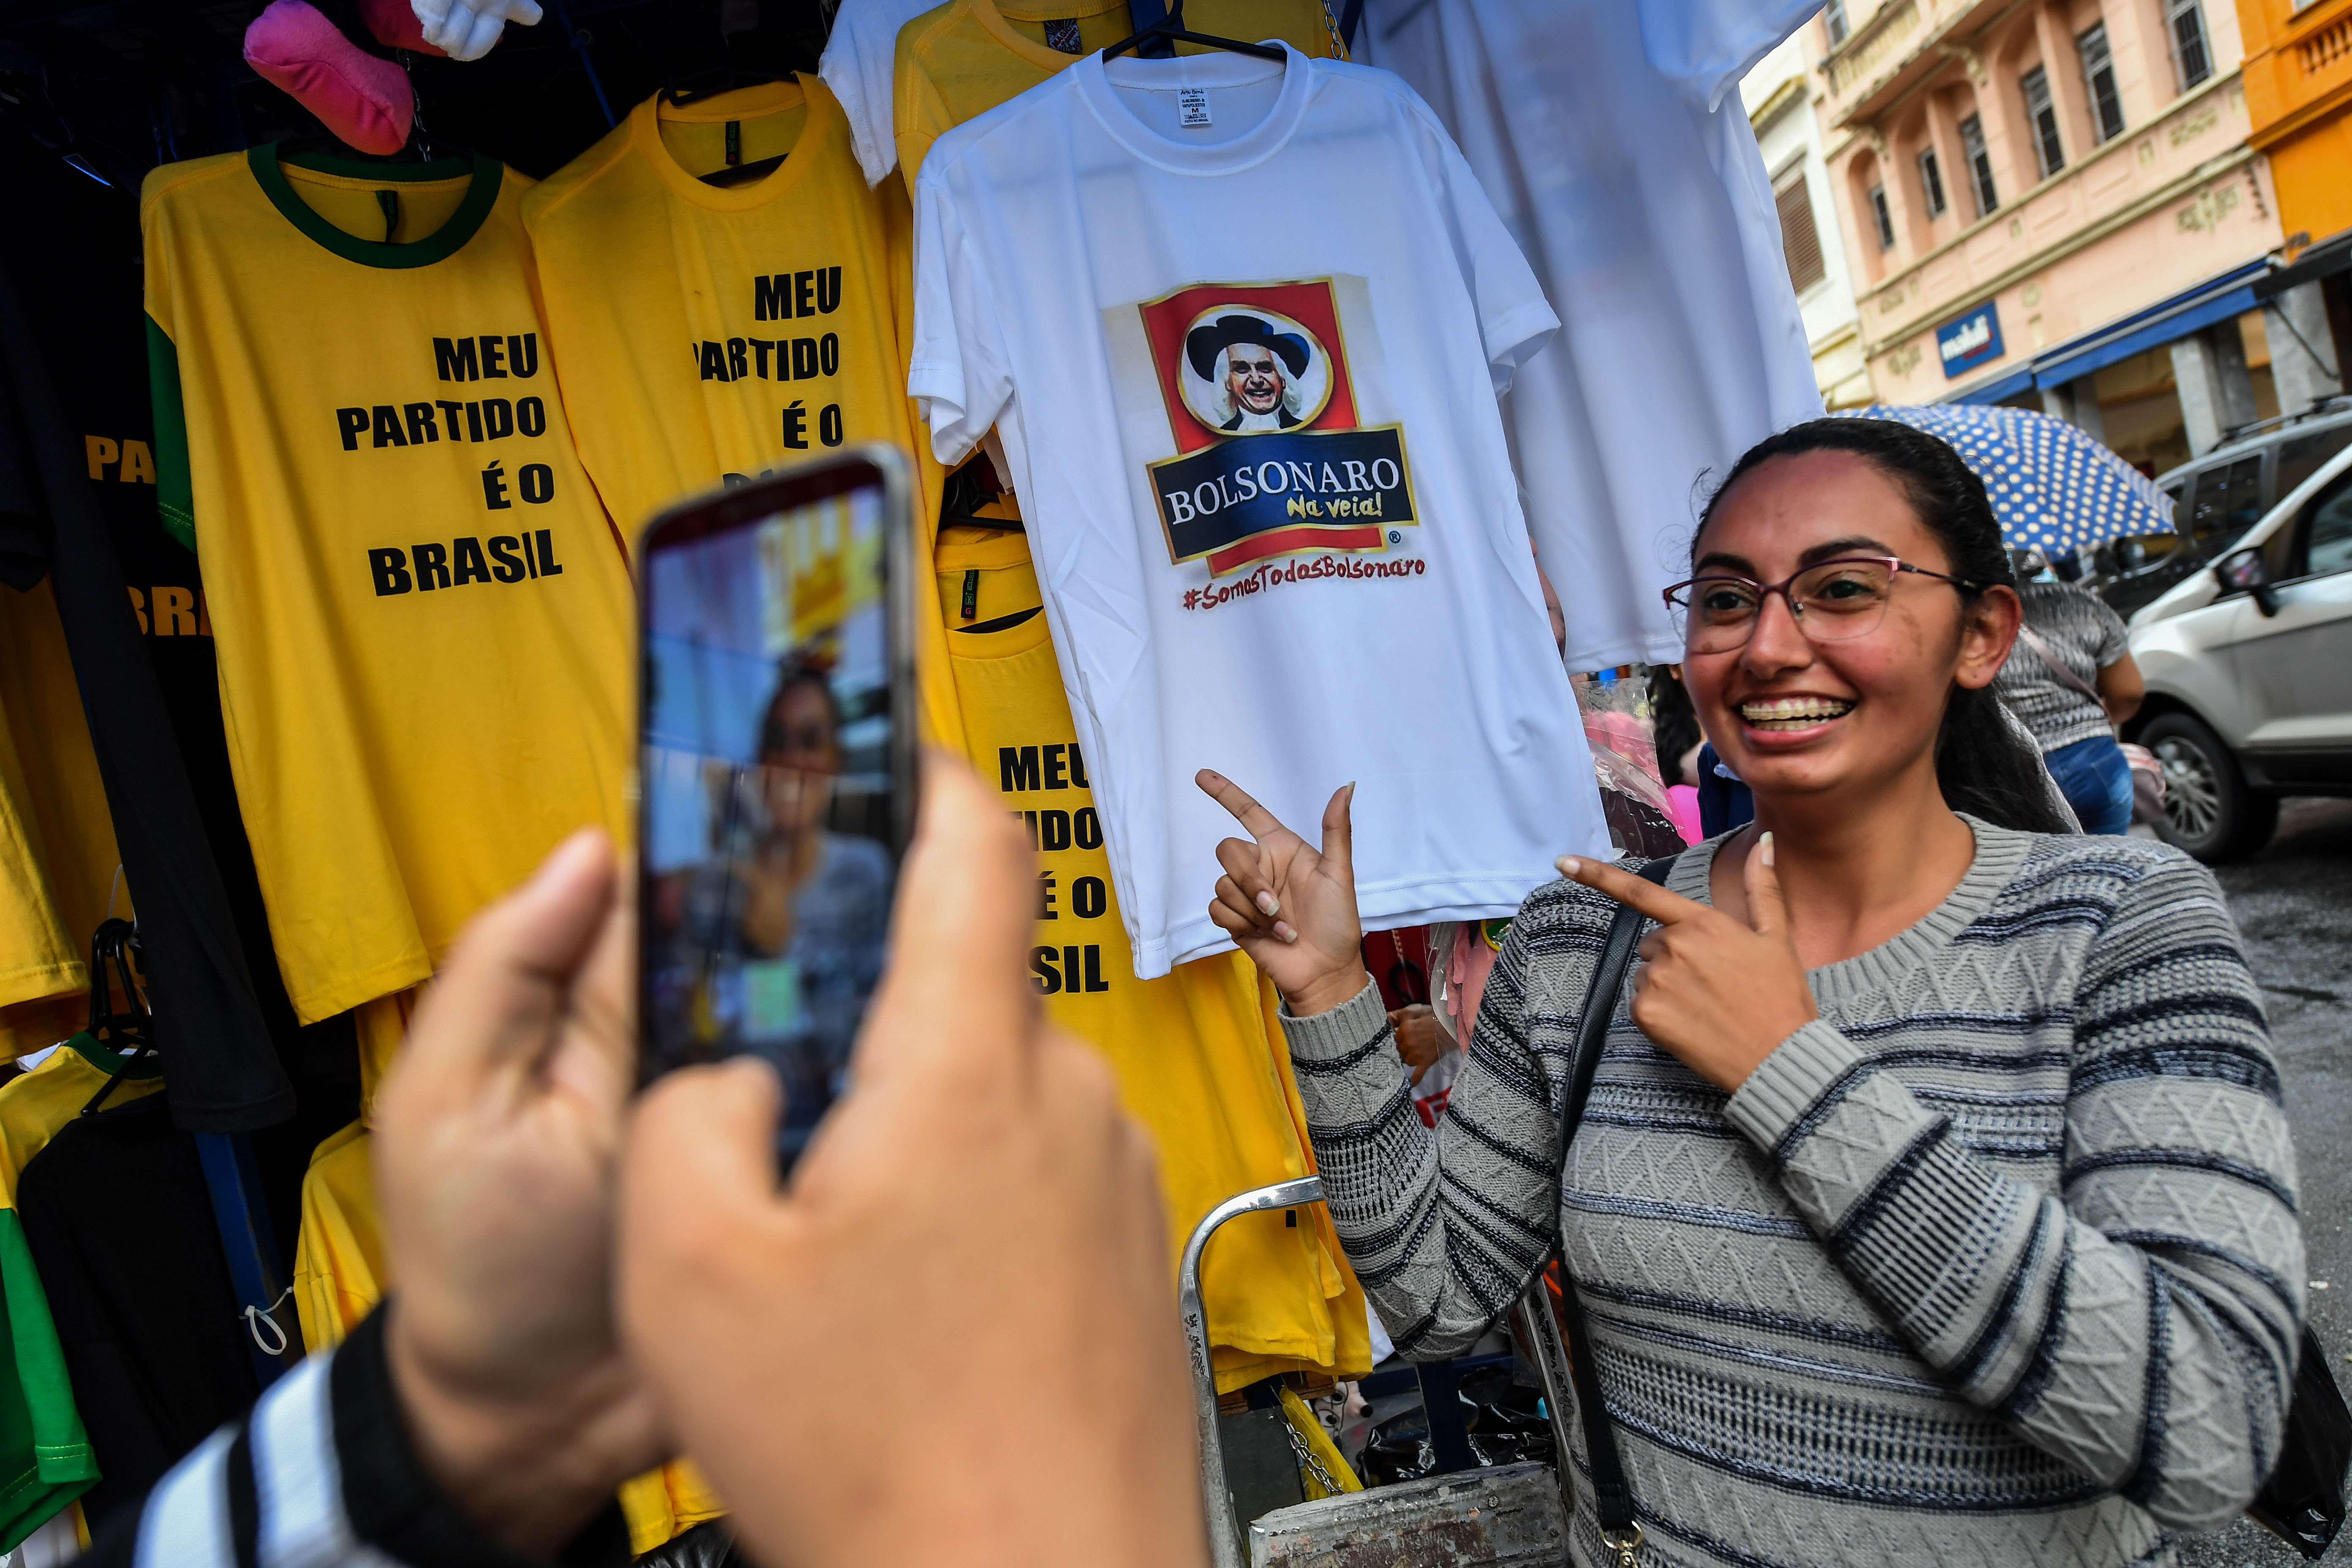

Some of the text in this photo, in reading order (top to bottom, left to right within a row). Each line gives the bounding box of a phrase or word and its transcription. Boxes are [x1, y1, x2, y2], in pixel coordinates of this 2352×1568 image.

[755, 266, 841, 321] MEU
[433, 333, 538, 382] MEU
[336, 396, 546, 451] PARTIDO
[783, 400, 843, 449] É O
[481, 460, 554, 510] É O
[1165, 458, 1399, 525] BOLSONARO
[1287, 492, 1382, 519] Na veia!
[368, 529, 563, 596] BRASIL
[1072, 876, 1107, 919] O
